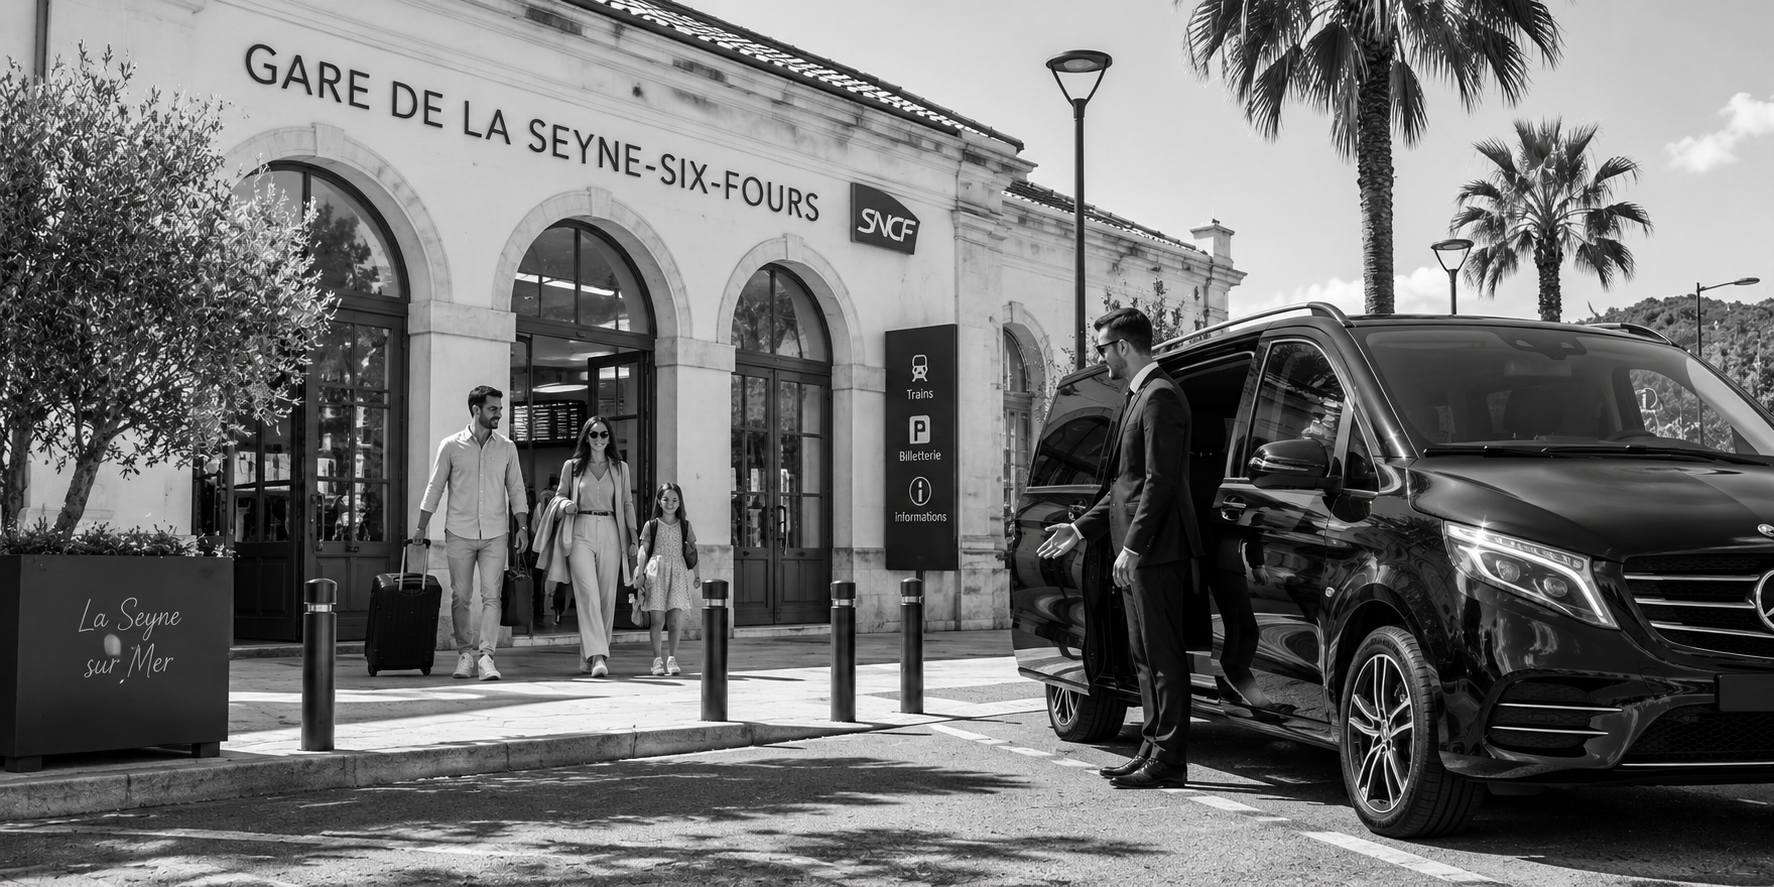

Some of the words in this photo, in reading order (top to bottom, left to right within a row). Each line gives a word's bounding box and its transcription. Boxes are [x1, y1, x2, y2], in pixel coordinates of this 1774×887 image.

[244, 43, 371, 111] GARE
[391, 80, 444, 129] DE
[463, 100, 512, 146] LA
[527, 118, 820, 222] SEYNE-SIX-FOURS
[857, 208, 917, 243] SNCF
[906, 388, 934, 400] Trains
[899, 449, 942, 462] Billetterie
[78, 598, 110, 633] La
[117, 596, 182, 642] Seyne
[83, 657, 121, 679] sur
[127, 642, 175, 679] Mer
